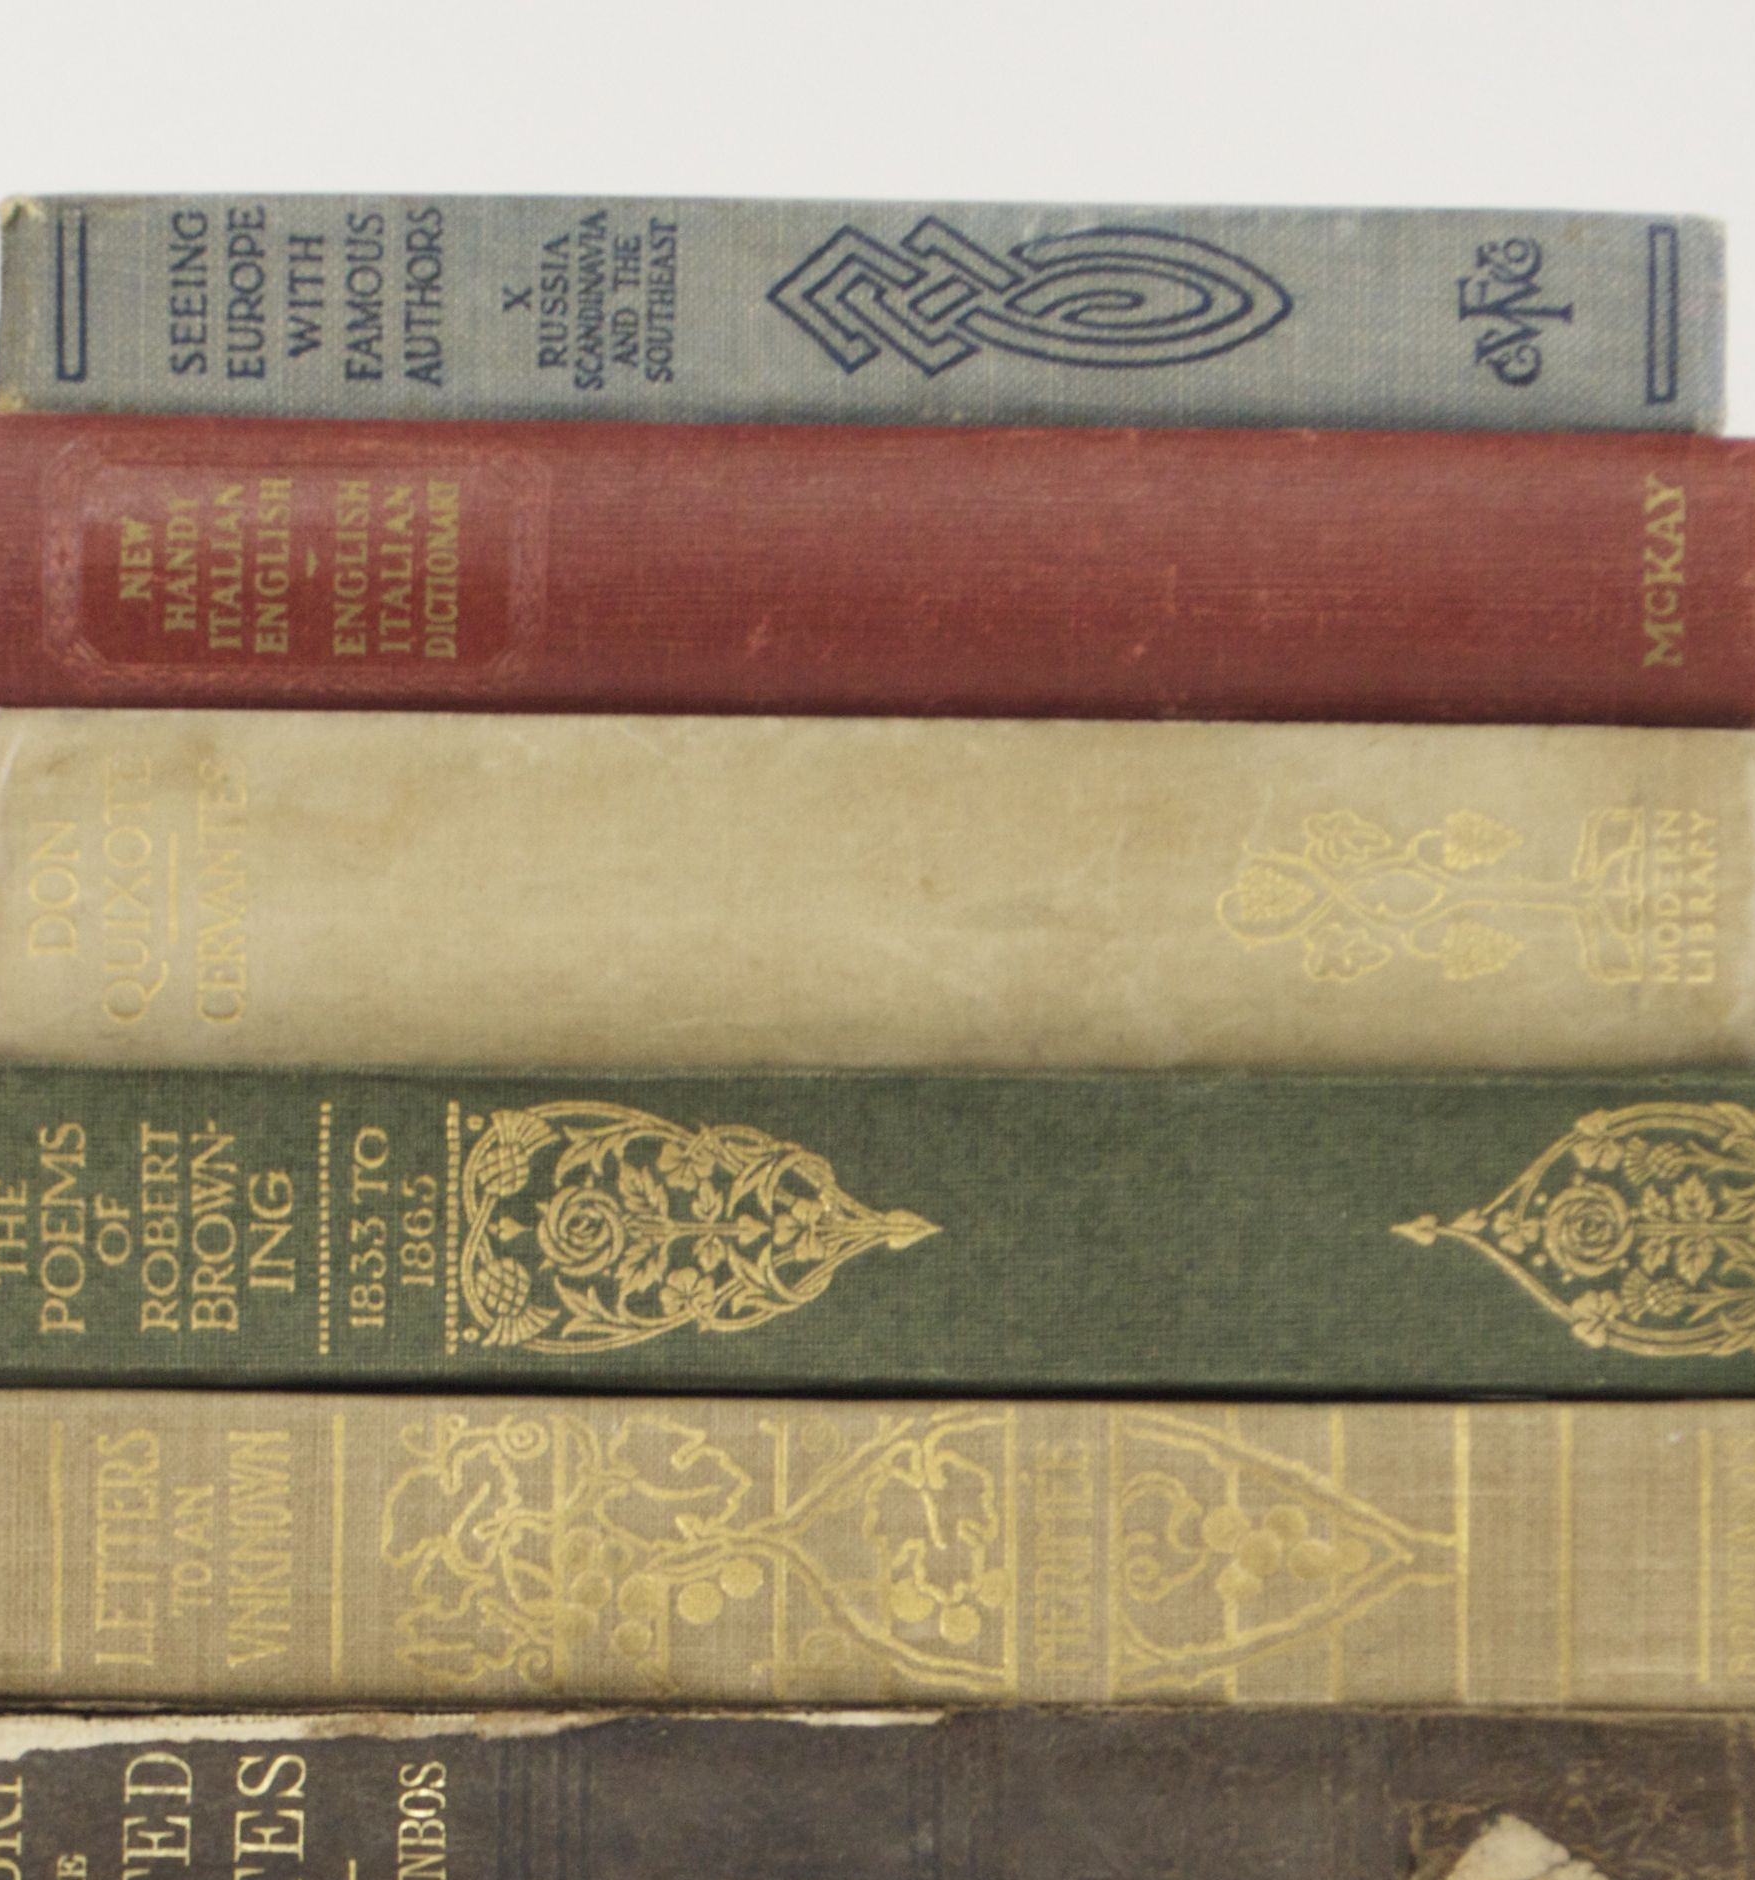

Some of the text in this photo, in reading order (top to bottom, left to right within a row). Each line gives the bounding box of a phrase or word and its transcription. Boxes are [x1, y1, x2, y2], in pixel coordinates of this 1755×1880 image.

[169, 208, 211, 377] SEEING
[227, 205, 267, 381] EUROPE
[287, 230, 327, 358] WITH
[344, 210, 385, 382] FAMOUS
[404, 205, 445, 386] AUTHORS
[502, 285, 534, 312] X
[538, 231, 571, 368] RUSSIA
[574, 208, 609, 390] SCANDINAVIA
[612, 234, 642, 366] AND THE
[647, 216, 679, 383] SOUTHEAST
[119, 515, 155, 601] NEW
[164, 493, 198, 632] HANDY
[209, 482, 246, 650] ITALIAN
[255, 477, 293, 654] ENGLISH
[334, 479, 371, 656] ENGLISH
[380, 483, 415, 652] ITALIAN
[425, 481, 461, 658] DICTIONARY
[27, 820, 82, 959] DON
[102, 753, 168, 1026] QUIXOTE
[197, 758, 247, 1026] CERVANTES
[1653, 808, 1684, 984] MODERN
[1686, 808, 1719, 985] LIBRARY
[39, 1120, 87, 1335] POEMS
[96, 1192, 133, 1267] OF
[141, 1121, 180, 1333] ROBERT
[191, 1117, 240, 1334] BROWN-
[249, 1169, 297, 1294] ING
[349, 1126, 391, 1330] 1833 TO
[400, 1173, 438, 1289] 1865
[95, 1426, 160, 1667] LETTERS
[172, 1483, 215, 1618] TO AN
